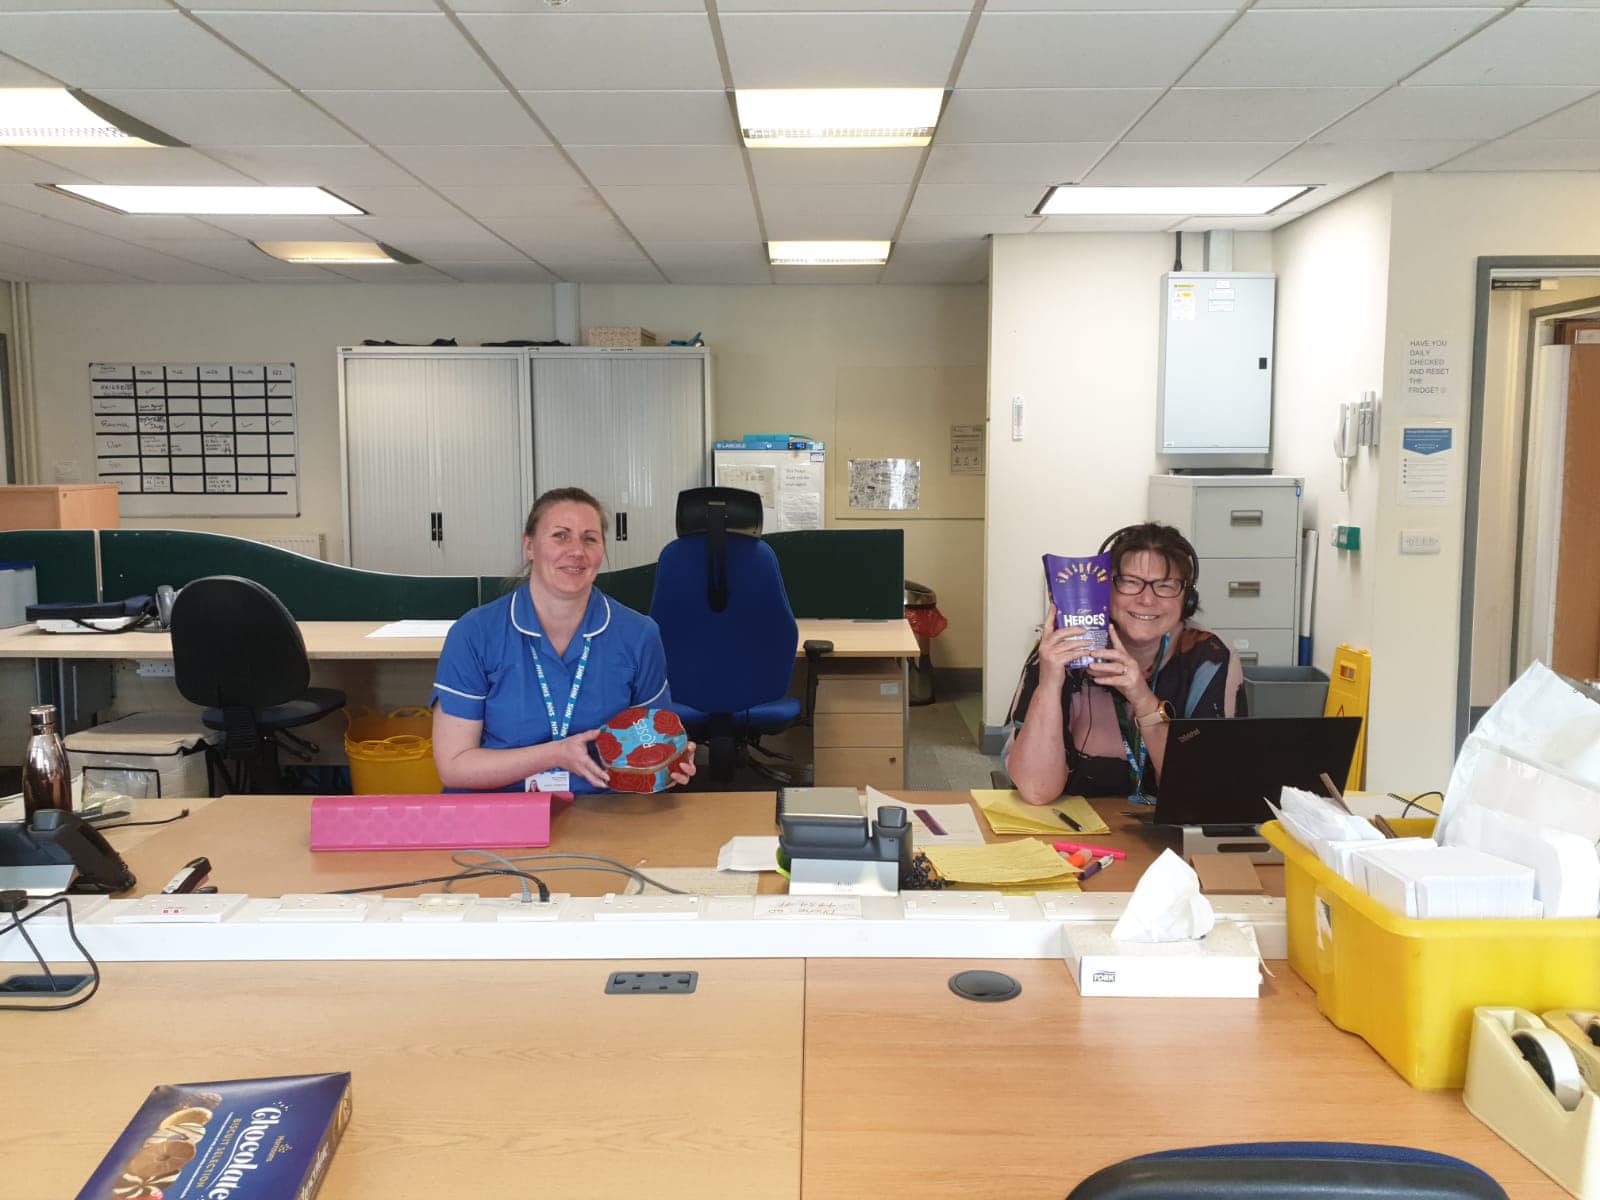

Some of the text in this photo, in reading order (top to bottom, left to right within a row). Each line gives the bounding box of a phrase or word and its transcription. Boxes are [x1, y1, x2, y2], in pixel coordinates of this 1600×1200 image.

[1063, 613, 1106, 627] HEROES
[535, 664, 545, 678] NHS
[575, 664, 585, 680] NHS
[540, 682, 550, 697] NHS
[570, 683, 580, 699] NHS
[545, 701, 555, 717] NHS
[564, 702, 574, 718] NHS
[550, 720, 560, 736] NHS
[196, 1118, 242, 1188] BISCUIT SELECTION
[207, 1107, 282, 1200] Chocolate
